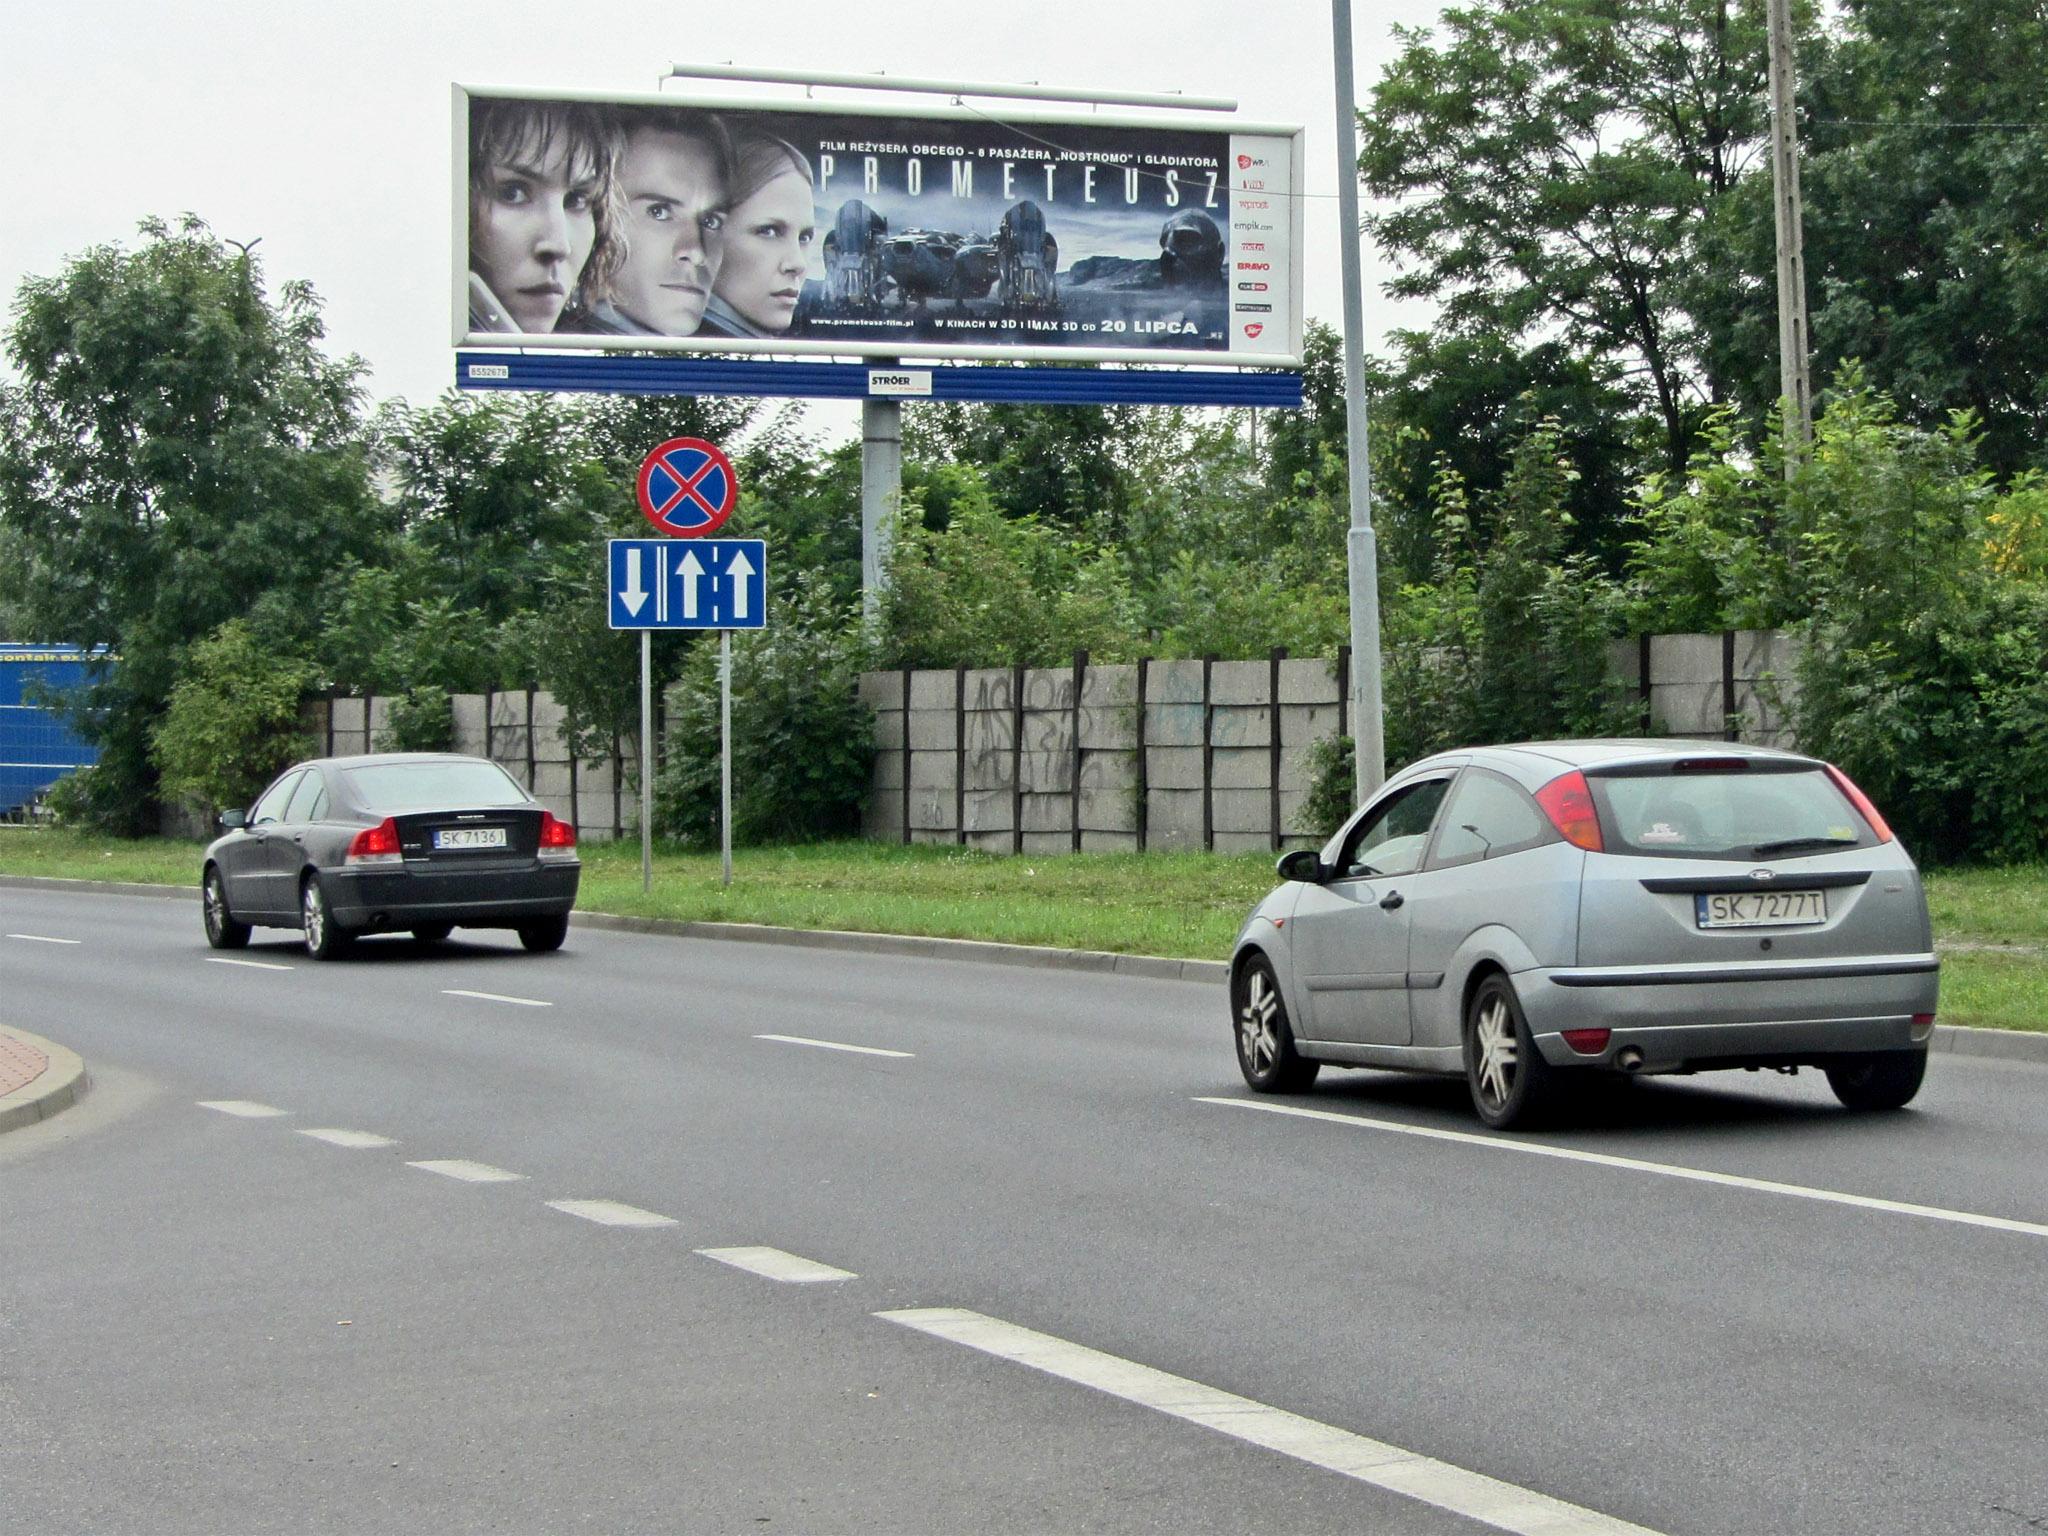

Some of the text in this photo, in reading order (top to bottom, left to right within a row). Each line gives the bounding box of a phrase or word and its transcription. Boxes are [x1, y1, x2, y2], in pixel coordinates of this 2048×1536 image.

[820, 141, 846, 151] FILM
[850, 141, 909, 154] REŻYSERA
[912, 144, 964, 156] OBCEGO
[978, 149, 985, 158] 8
[989, 147, 1051, 160] PASAŻERA
[1137, 155, 1141, 164] I
[1145, 155, 1219, 168] GLADIATORA
[820, 154, 1219, 208] PROMETEUSZ
[1237, 262, 1270, 271] BRAVO
[934, 319, 944, 328] W
[947, 319, 986, 329] KINACH
[988, 320, 997, 329] W
[1000, 319, 1017, 329] 3D
[1027, 319, 1058, 331] IMAX
[1062, 322, 1078, 332] 3D
[1081, 323, 1096, 332] OD
[1100, 319, 1127, 333] 20
[1133, 320, 1199, 335] LIPCA
[441, 831, 460, 845] SK
[1712, 893, 1820, 920] SK 7277T
